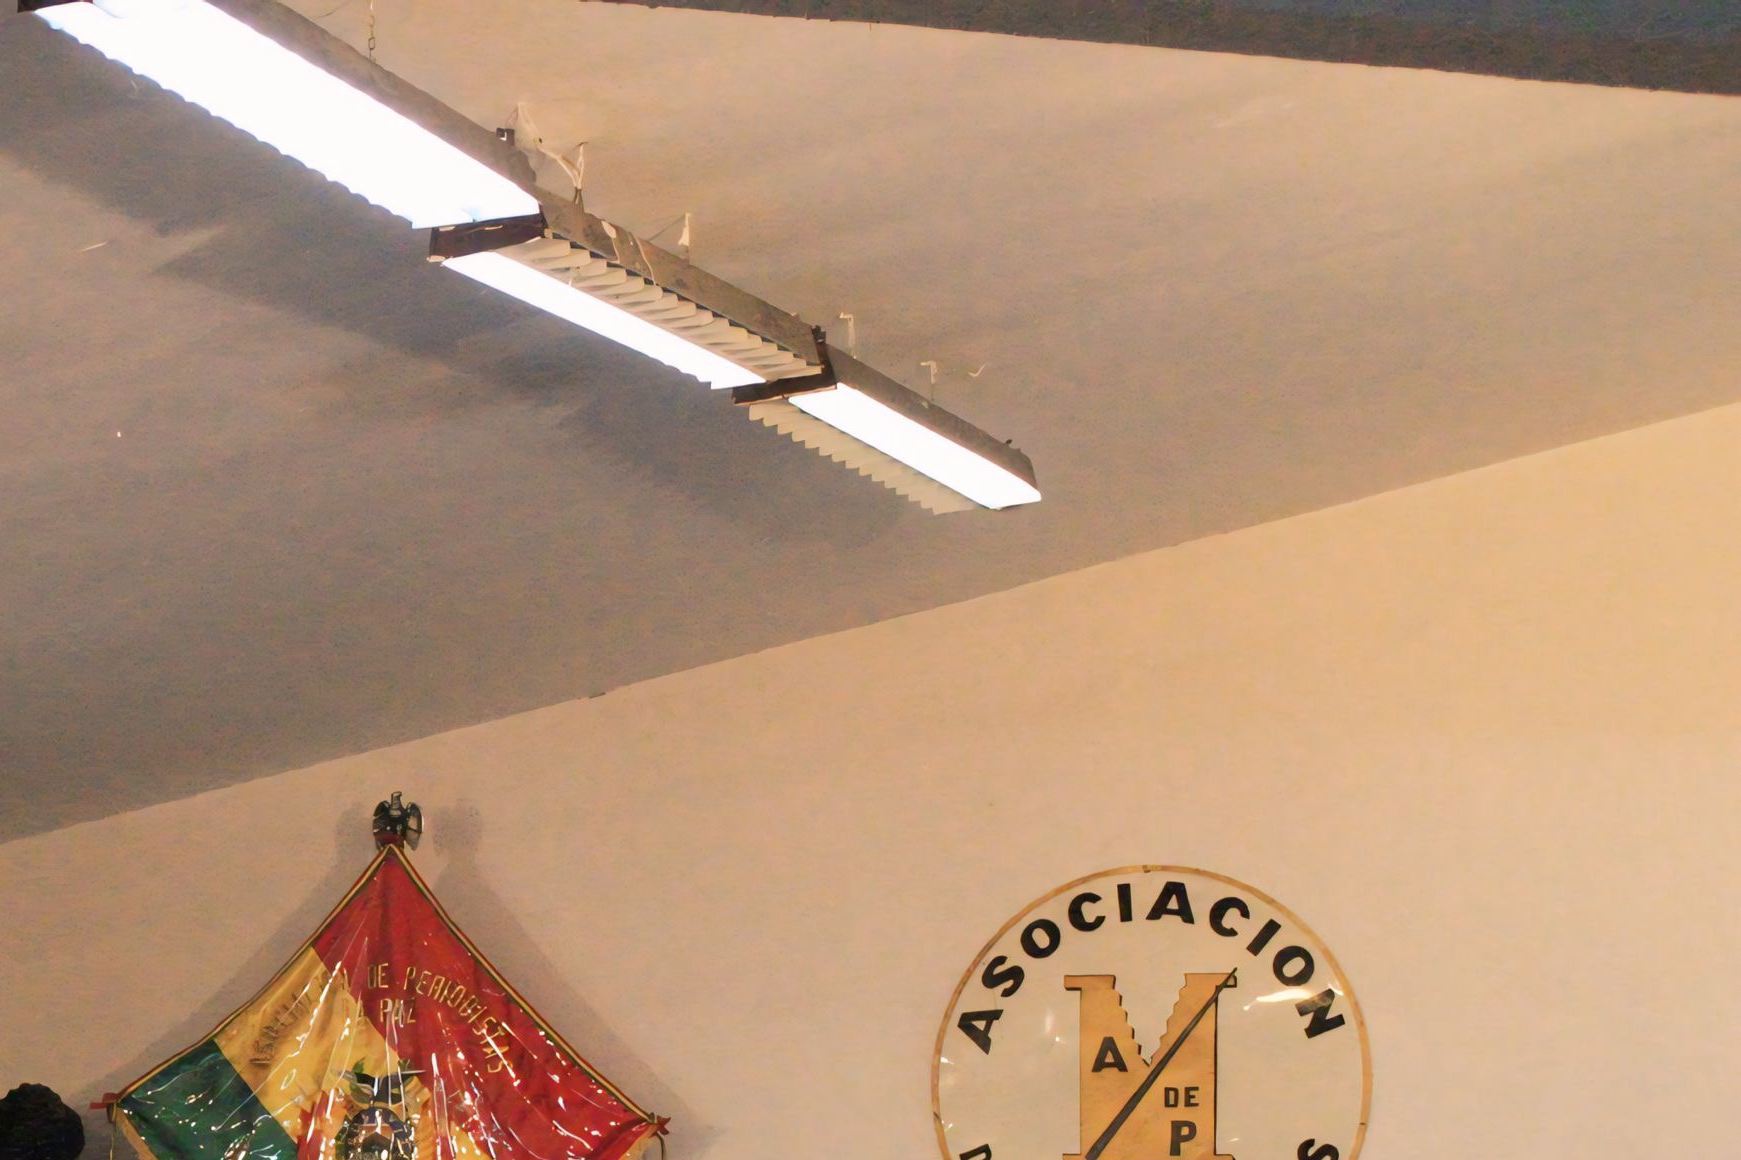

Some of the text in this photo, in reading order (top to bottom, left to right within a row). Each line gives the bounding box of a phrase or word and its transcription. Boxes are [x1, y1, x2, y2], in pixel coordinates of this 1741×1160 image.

[957, 881, 1346, 1055] ASOCIACION
[1092, 1036, 1128, 1073] A
[1164, 1086, 1200, 1108] DE
[1169, 1120, 1197, 1156] P
